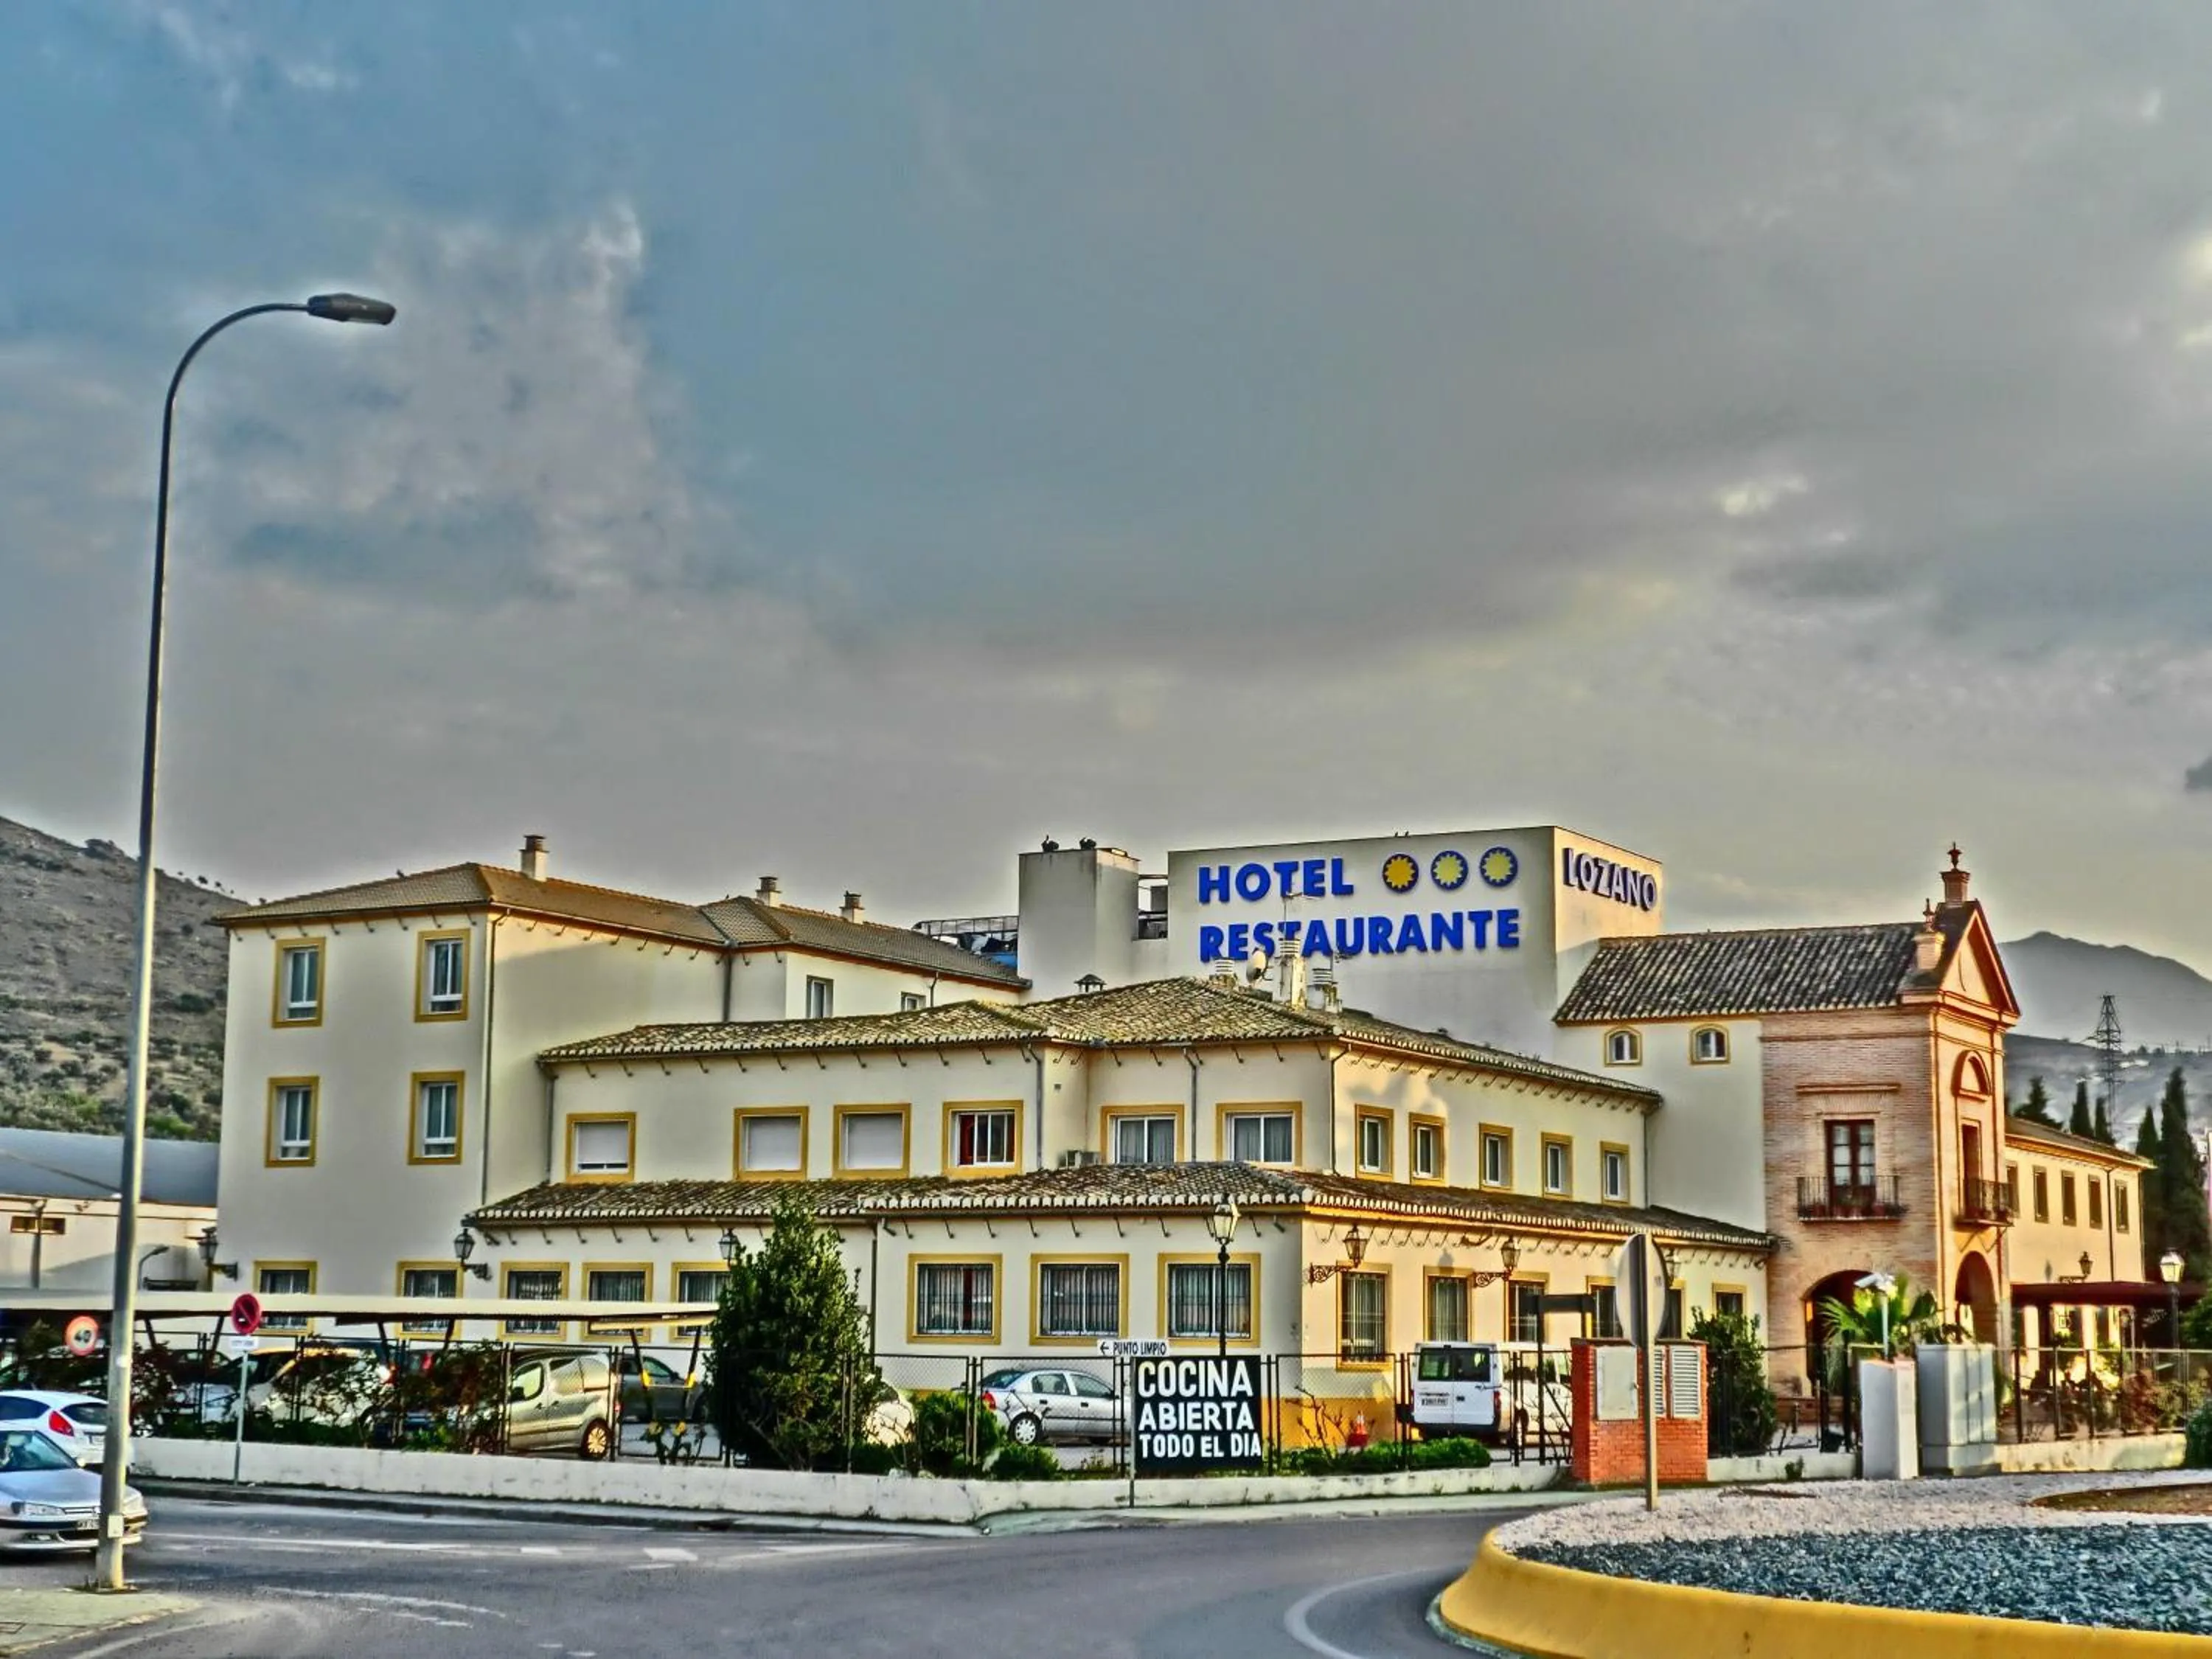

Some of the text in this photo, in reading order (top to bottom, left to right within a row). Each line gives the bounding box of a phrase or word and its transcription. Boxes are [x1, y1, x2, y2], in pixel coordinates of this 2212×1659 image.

[1198, 858, 1354, 904] HOTEL
[1562, 847, 1658, 912] LOZANO
[1200, 908, 1520, 963] RESTAURANTE
[1113, 1340, 1167, 1356] PUNTO LIMPIO
[1138, 1360, 1253, 1398] COCINA
[1138, 1401, 1254, 1431] ABIERTA
[1139, 1432, 1262, 1458] TODO EL DIA
